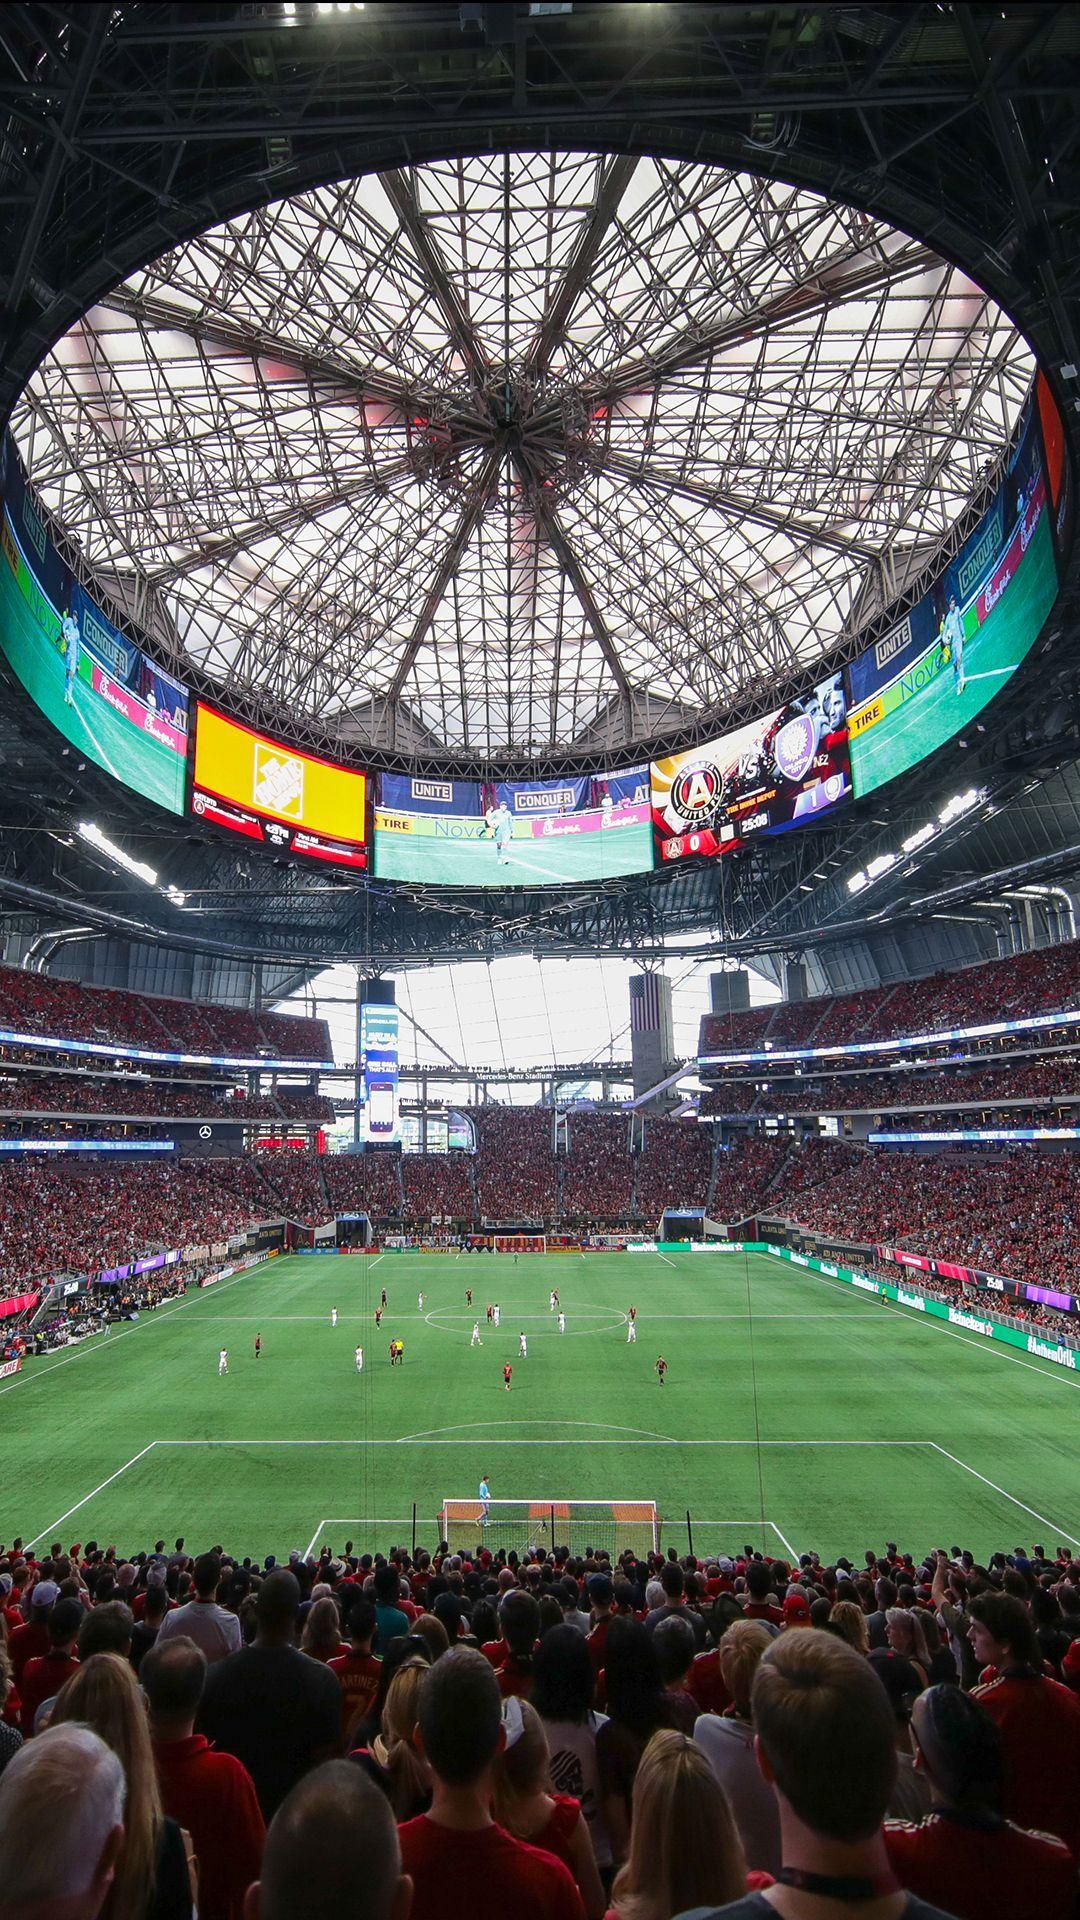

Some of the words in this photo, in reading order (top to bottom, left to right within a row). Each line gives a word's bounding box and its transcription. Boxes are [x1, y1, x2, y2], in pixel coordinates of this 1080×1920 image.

[962, 525, 1000, 589] CONQUER
[85, 620, 125, 669] CONQUER
[879, 627, 909, 661] UNITE
[855, 705, 880, 729] TIRE
[415, 783, 450, 798] UNITE
[518, 792, 572, 807] CONQUER
[687, 773, 712, 808] A
[726, 804, 738, 814] THE
[740, 798, 756, 810] HOME
[757, 790, 776, 804] DEPOT
[677, 805, 710, 820] UNITED
[383, 818, 409, 830] TIRE
[690, 835, 700, 851] 0
[476, 1072, 524, 1080] Mercedes-Benz
[525, 1072, 552, 1080] Stadium
[845, 1251, 865, 1263] UNITED
[948, 1307, 985, 1334] Heineken
[1027, 1335, 1076, 1368] #AnthemOfUs
[342, 1673, 380, 1689] ARTINEZ
